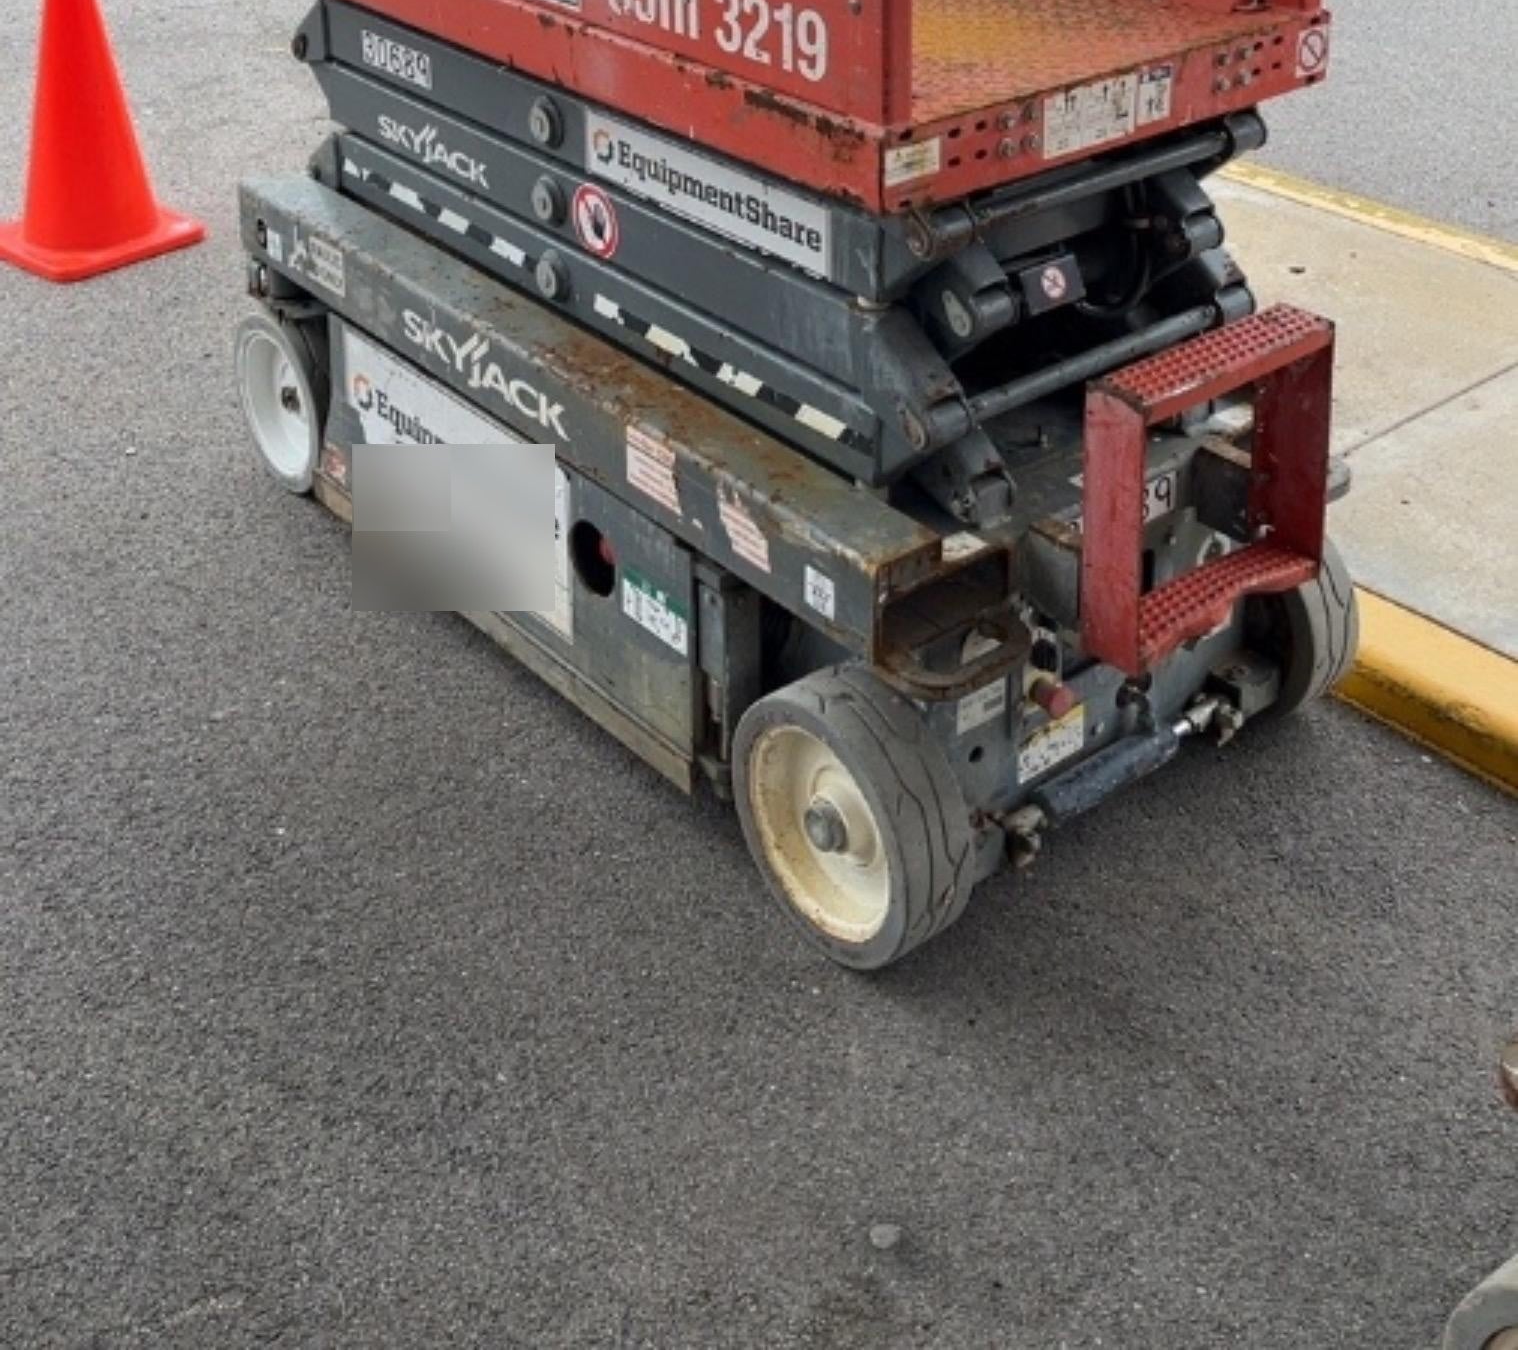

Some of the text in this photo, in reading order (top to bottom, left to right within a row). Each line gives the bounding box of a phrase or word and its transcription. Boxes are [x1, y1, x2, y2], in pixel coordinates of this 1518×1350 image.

[377, 113, 489, 189] SKYJACK
[617, 140, 822, 252] EquipmentShare
[402, 308, 571, 442] SKYJACK
